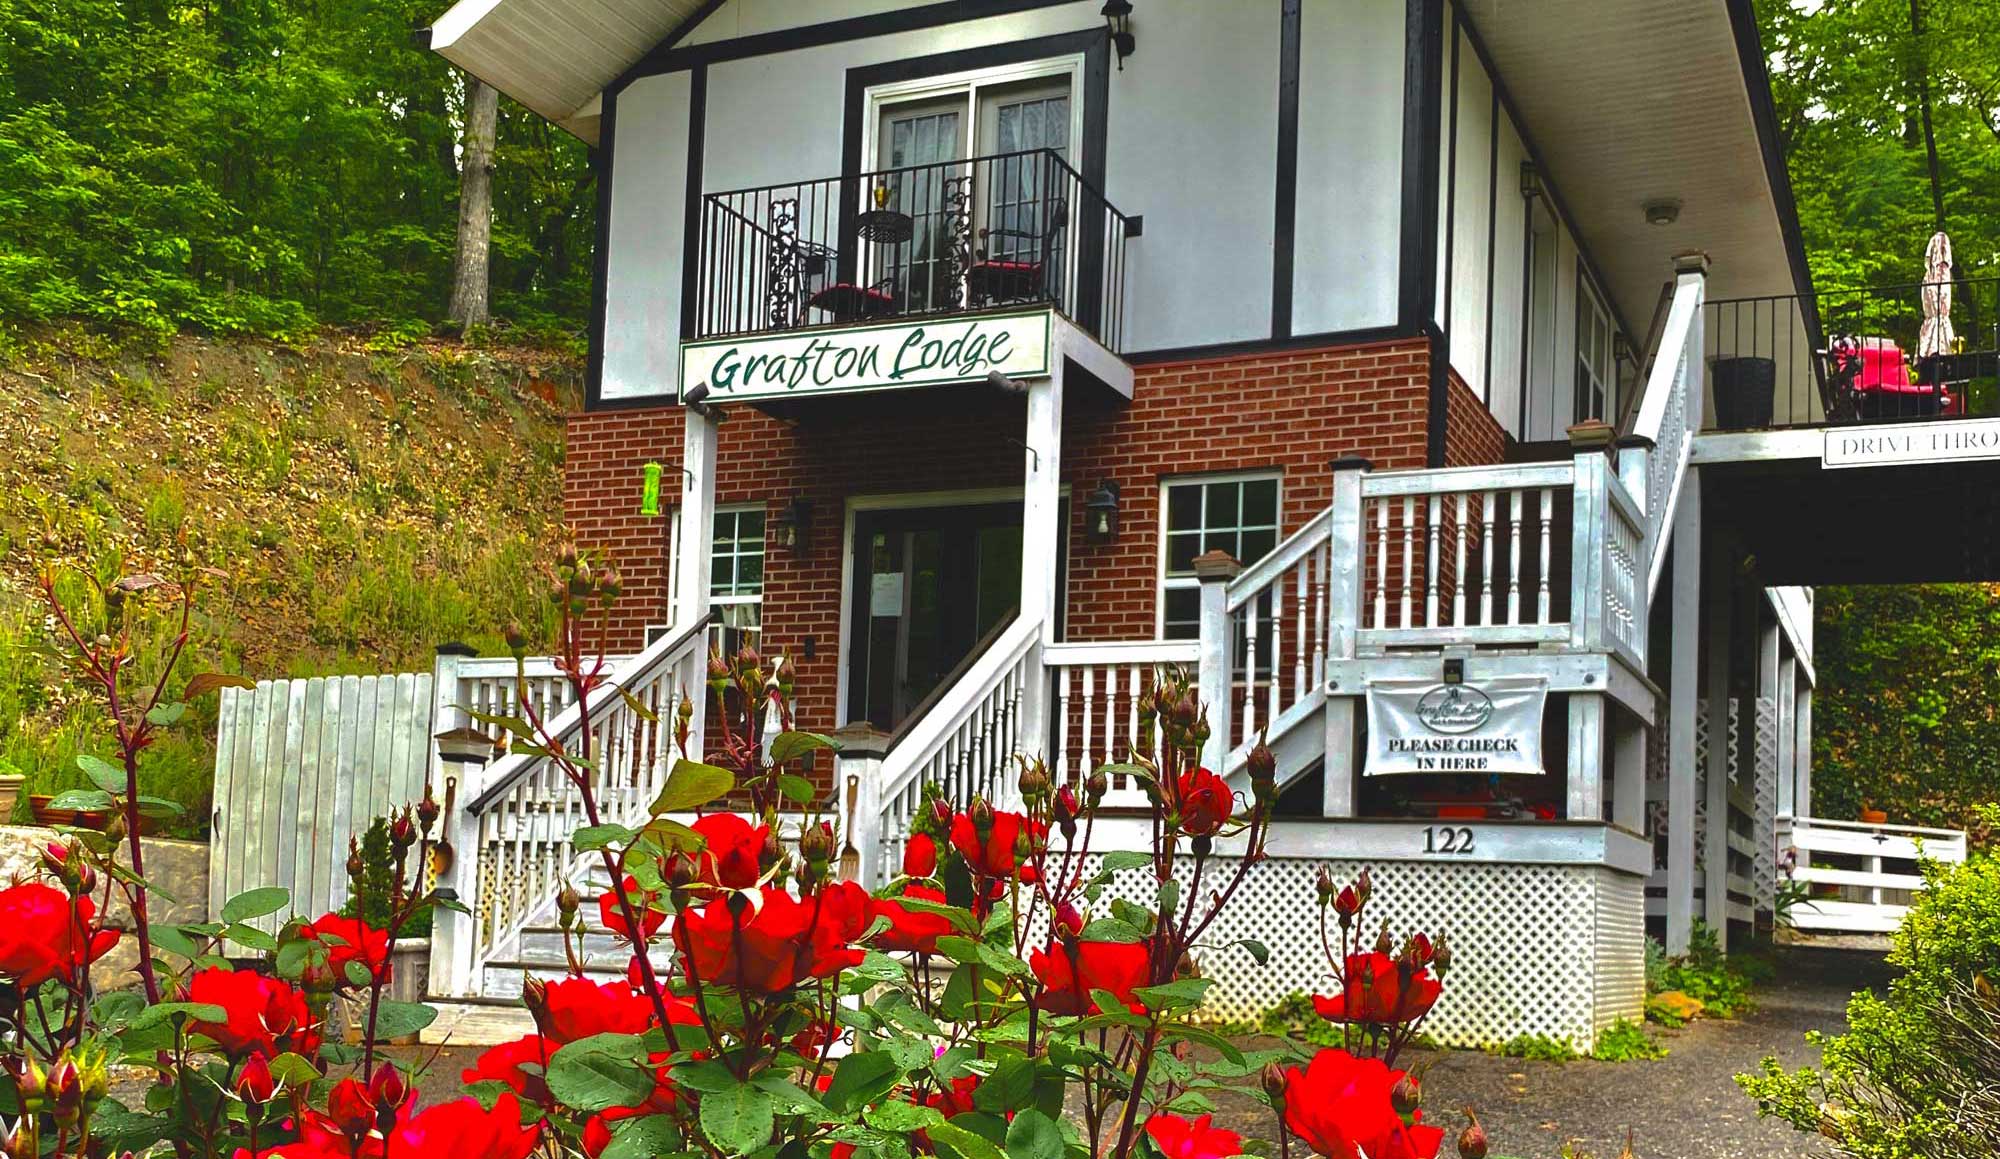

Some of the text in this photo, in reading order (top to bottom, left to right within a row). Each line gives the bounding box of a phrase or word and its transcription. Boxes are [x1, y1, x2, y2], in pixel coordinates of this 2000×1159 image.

[711, 322, 1014, 392] Grafton Lodge
[1843, 435, 1914, 455] DRIVE
[1389, 738, 1518, 752] PLEASE CHECK
[1417, 757, 1488, 770] IN HERE
[1422, 826, 1475, 854] 122
